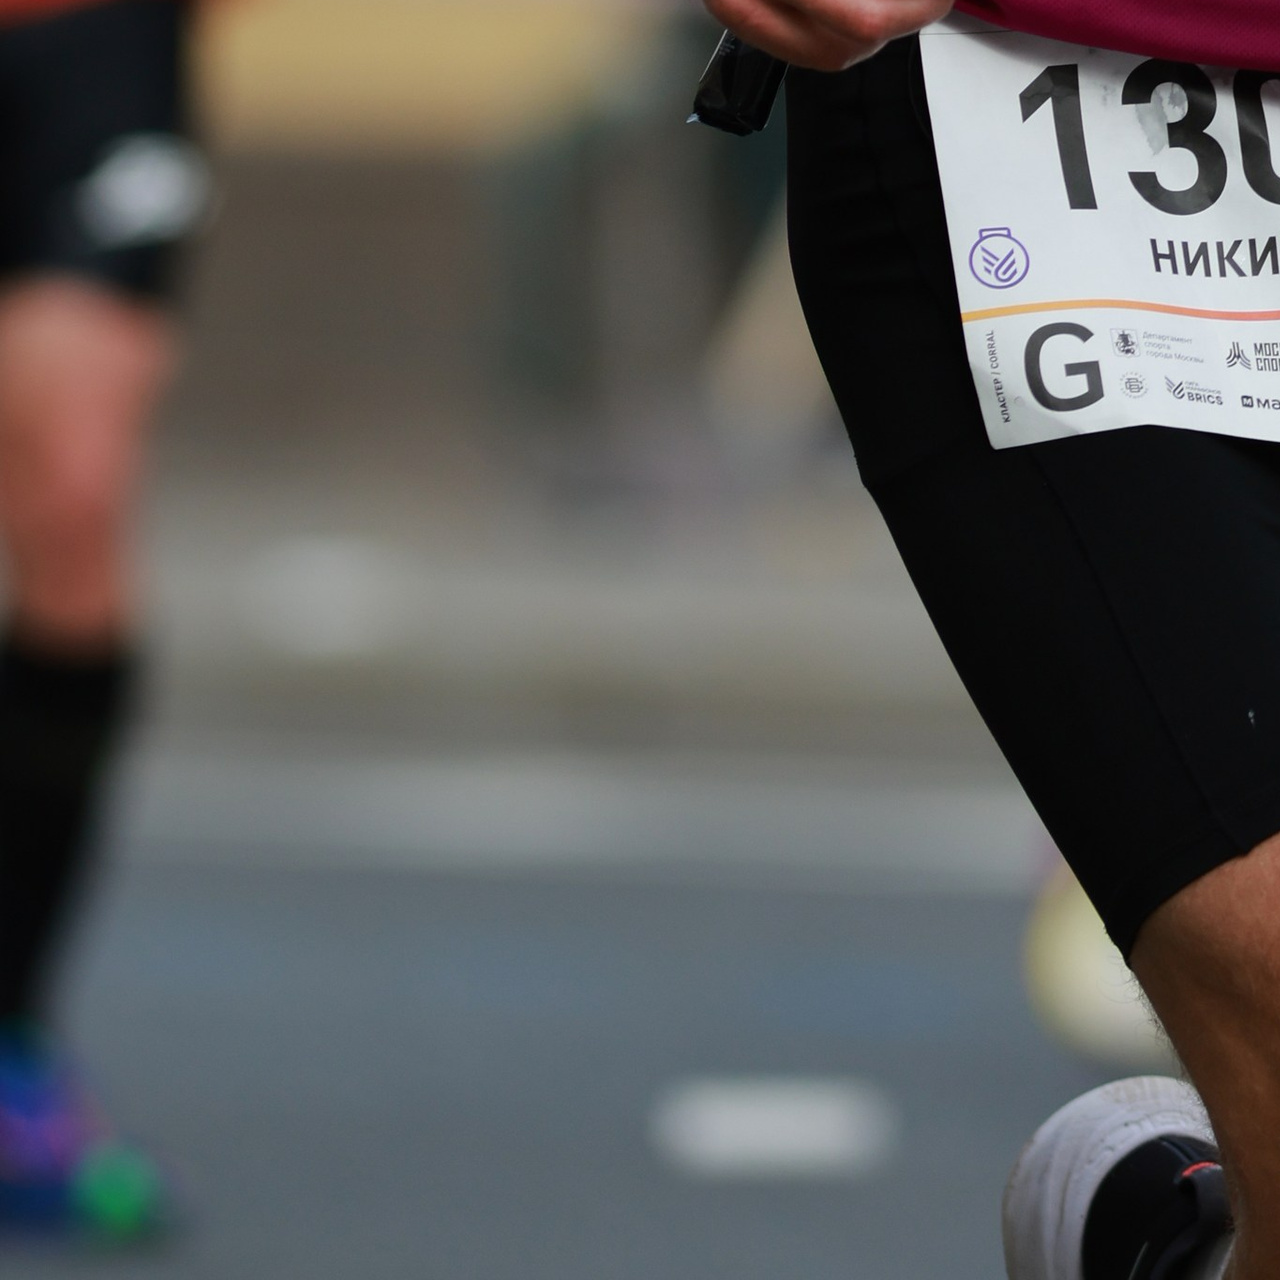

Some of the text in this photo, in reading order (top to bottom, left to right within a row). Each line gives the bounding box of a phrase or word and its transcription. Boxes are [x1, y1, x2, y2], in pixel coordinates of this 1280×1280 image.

[986, 330, 999, 370] CORRAL
[1023, 322, 1105, 412] G
[993, 378, 1011, 424] КЛАСТЕР
[1187, 392, 1224, 406] BRICS
